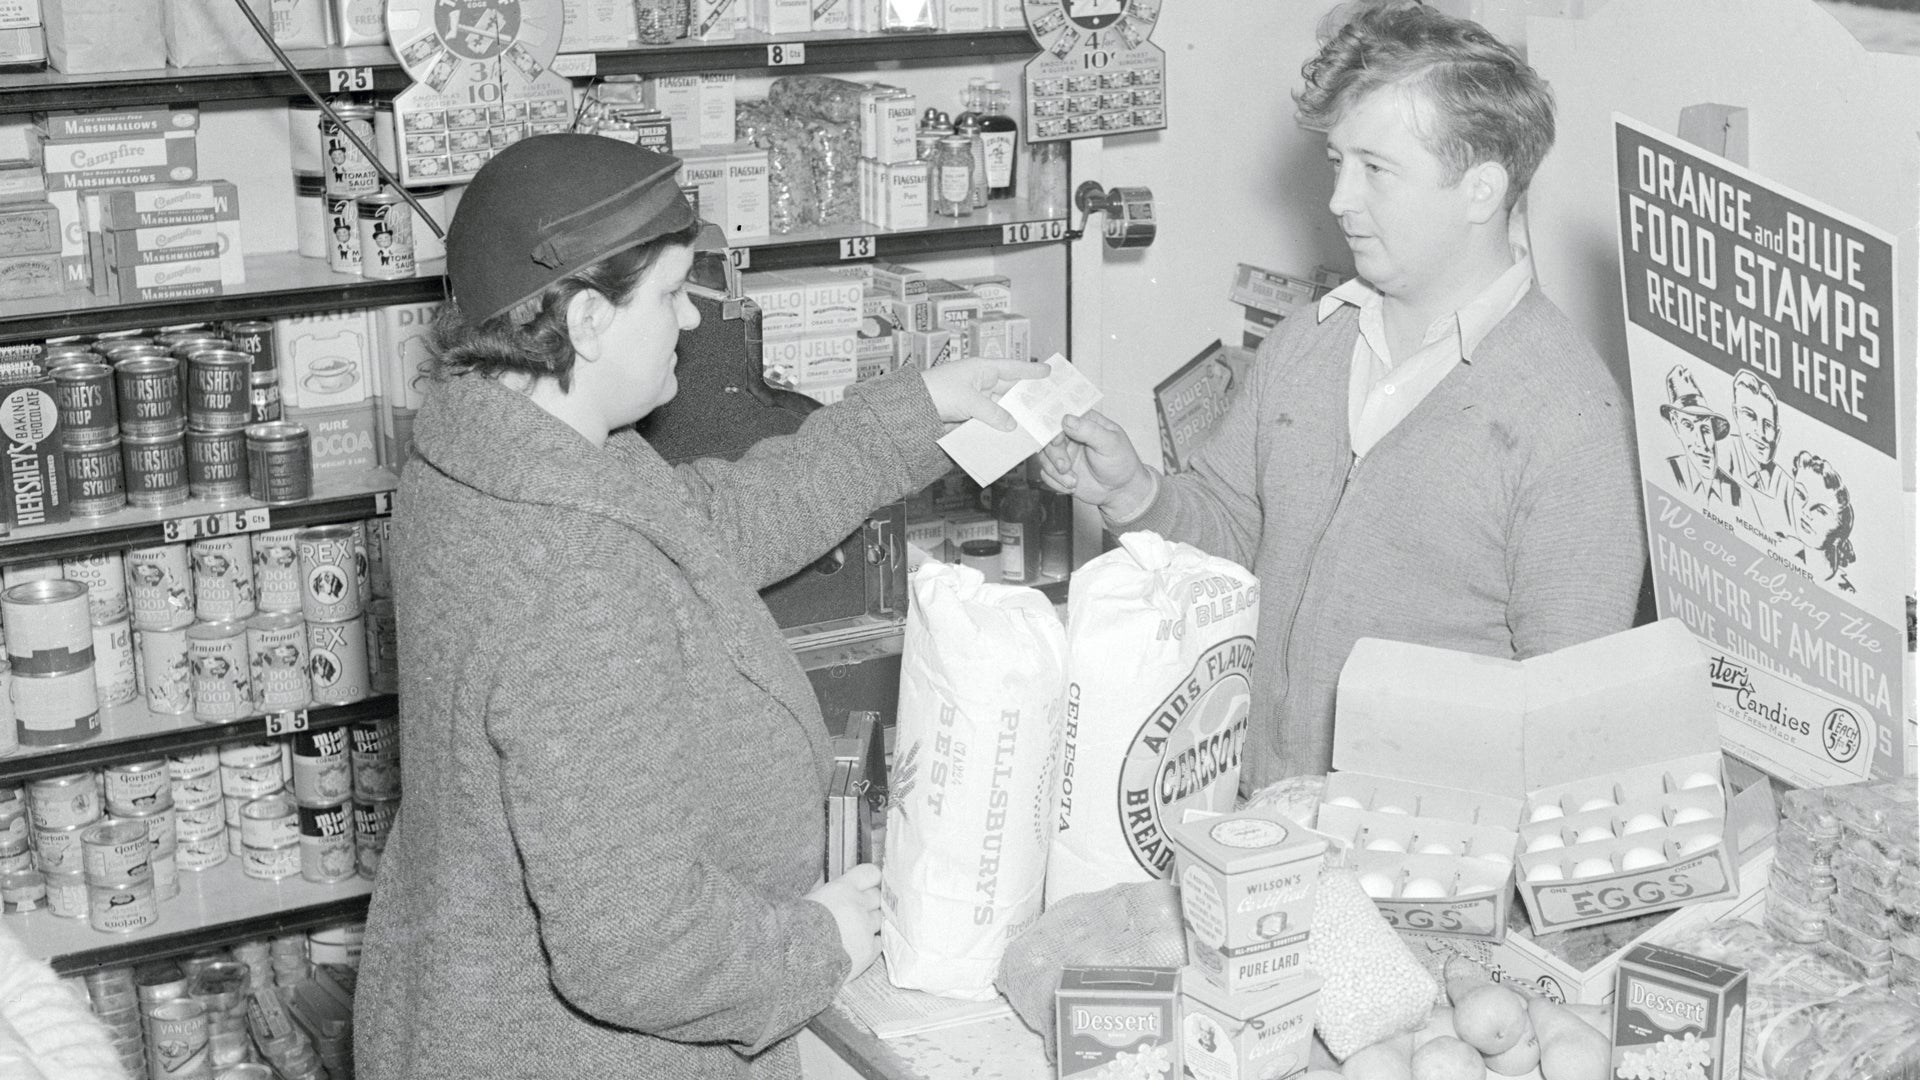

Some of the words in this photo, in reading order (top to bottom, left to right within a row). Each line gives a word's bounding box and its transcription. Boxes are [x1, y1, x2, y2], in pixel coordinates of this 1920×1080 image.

[1084, 32, 1100, 50] 4
[772, 46, 782, 64] 8
[470, 62, 488, 82] 3
[659, 78, 698, 88] FLAGSTAFF
[65, 120, 158, 134] MARSHMALLOWS
[70, 144, 145, 168] Campfire
[64, 174, 156, 188] MARSHMALLOWS
[344, 172, 376, 180] TOMATO
[687, 170, 724, 180] FLAGSTAFF
[730, 166, 765, 178] FLAGSTAFF
[154, 190, 202, 210] Campfire
[141, 214, 214, 225] MARSHMALLOWS
[1638, 145, 1752, 240] ORANGE
[1754, 224, 1784, 255] and
[1786, 212, 1866, 292] BLUE
[155, 228, 202, 247] Campfire
[1009, 224, 1030, 242] 10
[1040, 222, 1061, 240] 10
[142, 249, 216, 264] MARSHMALLOWS
[390, 253, 414, 262] TOMAT
[847, 238, 869, 258] 13
[1629, 194, 1717, 290] FOOD
[1734, 244, 1880, 369] STAMPS
[142, 287, 214, 300] MARSHMALLOWS
[810, 288, 861, 306] JELL-O
[400, 306, 440, 326] DIX
[946, 310, 968, 320] STAR
[805, 338, 854, 358] JELL-O
[1646, 268, 1782, 380] REDEEMED
[1792, 340, 1868, 423] HERE
[200, 394, 232, 408] YRUP
[1168, 377, 1212, 418] Lamps
[12, 396, 28, 439] BAKING
[27, 391, 44, 440] CHOCOLATE
[61, 410, 92, 426] YRUP
[136, 402, 172, 418] SYRUP
[319, 420, 349, 432] PURE
[312, 431, 374, 457] OCOA
[144, 472, 178, 489] SYRUP
[204, 464, 238, 480] SYRUP
[7, 442, 45, 526] HERSHEY'S
[82, 480, 117, 496] SYRUP
[166, 522, 179, 539] 3
[193, 516, 220, 538] 10
[236, 512, 247, 530] 5
[1702, 508, 1735, 532] FARMER
[1736, 516, 1777, 546] MERCHANT
[302, 540, 351, 568] REX
[266, 570, 293, 580] DOG
[1658, 494, 1696, 542] We
[1704, 539, 1737, 568] are
[1744, 557, 1830, 630] helping
[1840, 611, 1882, 654] the
[1767, 549, 1815, 584] CONSUMER
[263, 581, 296, 592] FOOD
[1191, 574, 1242, 604] PURE
[1196, 585, 1259, 628] BLEAC
[1669, 586, 1717, 644] MOVE
[1658, 534, 1752, 630] FARMERS
[1758, 600, 1783, 649] OF
[1788, 622, 1893, 718] AMERICA
[313, 627, 348, 652] EX
[270, 670, 298, 681] DOG
[266, 680, 300, 692] FOOD
[1143, 678, 1201, 754] ADDS
[1736, 688, 1810, 736] Candies
[270, 716, 282, 733] 5
[294, 712, 306, 729] 5
[1836, 722, 1859, 739] EACH
[1770, 724, 1796, 744] MADE
[1828, 732, 1836, 750] 5
[928, 702, 958, 817] BEST
[1059, 682, 1082, 833] CERESOTA
[1161, 717, 1248, 805] CERESOT
[120, 770, 162, 783] Gorton's
[974, 708, 1020, 926] PILLSBURY'S
[1127, 788, 1176, 872] BREAD
[1247, 874, 1301, 894] WILSON'S
[1572, 874, 1694, 916] EGGS
[1379, 908, 1463, 930] GGS
[1240, 960, 1269, 980] PURE
[1272, 952, 1300, 972] LARD
[1632, 982, 1704, 1022] Dessert
[160, 1024, 182, 1035] VAN
[1076, 1009, 1157, 1031] Dessert
[1258, 1014, 1304, 1040] WILSON'S
